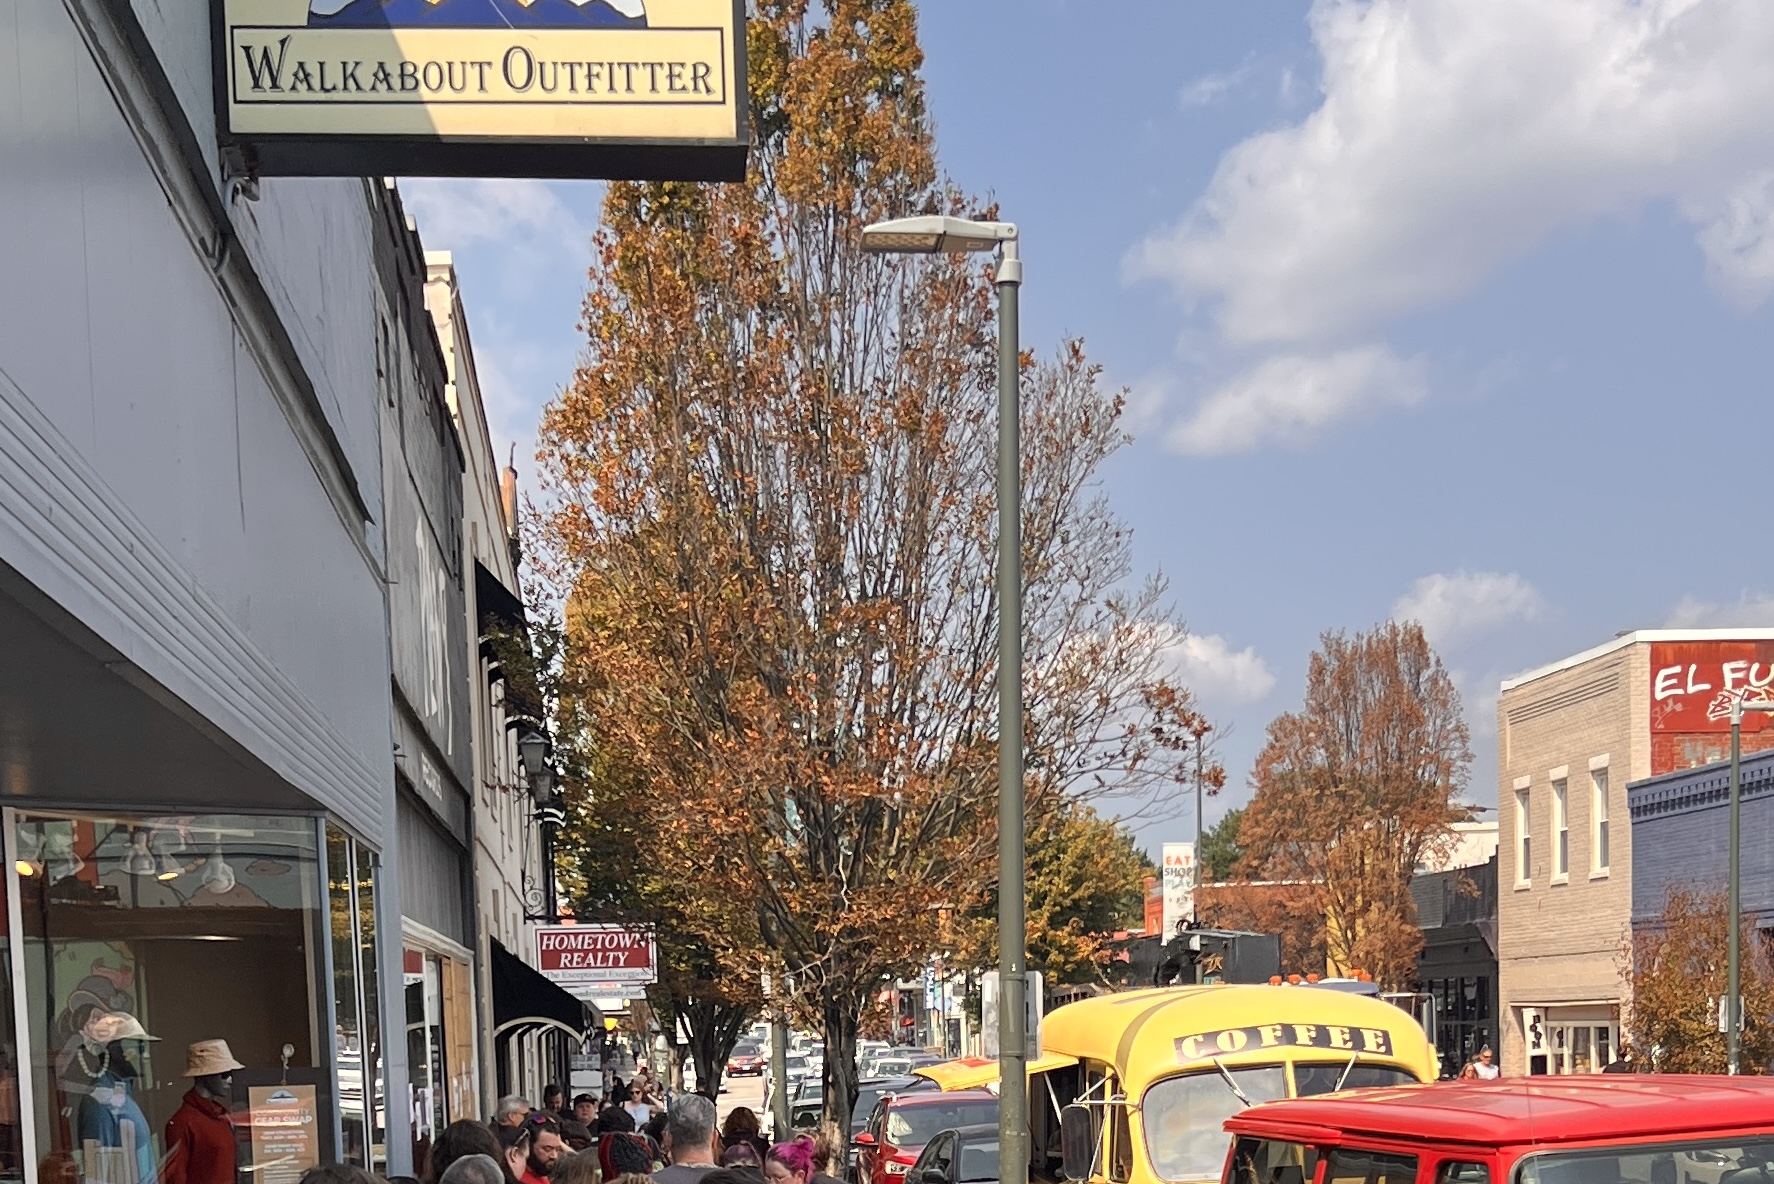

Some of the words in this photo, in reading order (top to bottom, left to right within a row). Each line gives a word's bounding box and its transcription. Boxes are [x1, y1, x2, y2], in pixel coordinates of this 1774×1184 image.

[241, 34, 494, 94] WALKABOUT
[502, 44, 717, 97] OUTFITTER
[1654, 663, 1712, 701] EL
[1165, 855, 1191, 866] EAT
[1164, 867, 1193, 878] SHOP
[542, 933, 647, 951] HOMETOWN
[559, 951, 630, 968] REALTY
[1181, 1024, 1387, 1059] COFFEE
